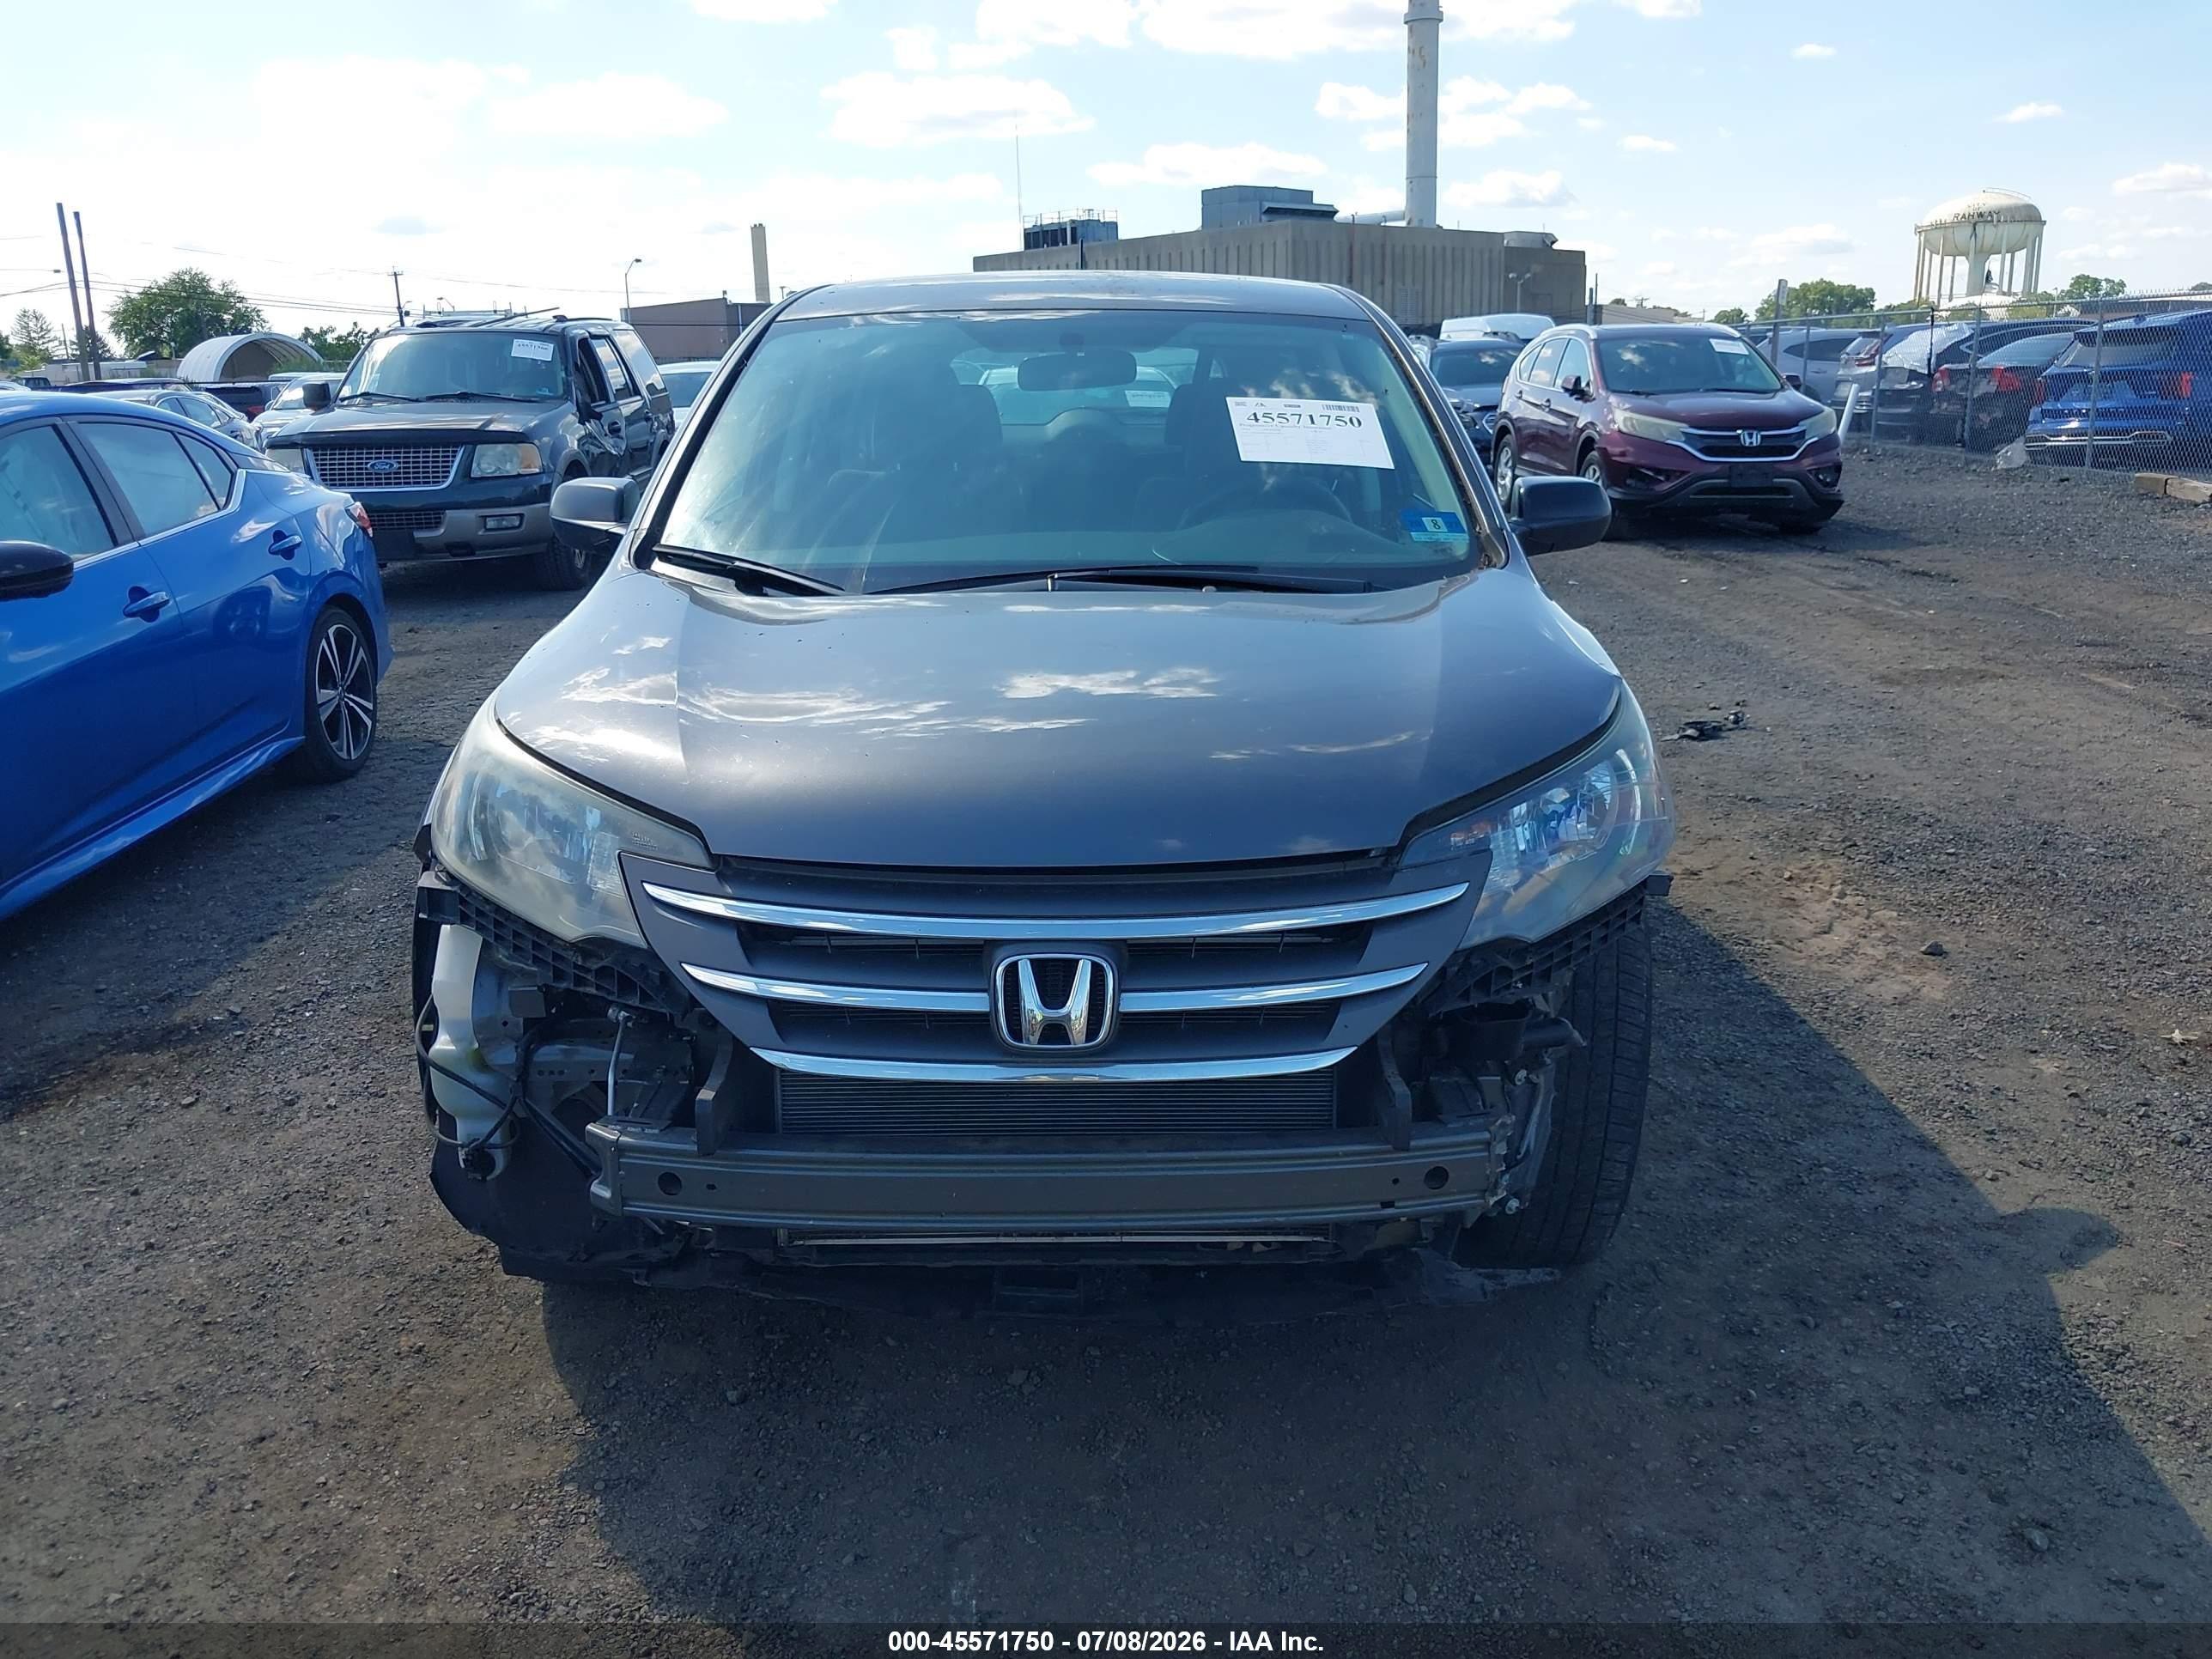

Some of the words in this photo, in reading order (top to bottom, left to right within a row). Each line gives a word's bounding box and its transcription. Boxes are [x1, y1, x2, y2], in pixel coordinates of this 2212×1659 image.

[1952, 210, 2001, 221] RAHWAY
[1246, 411, 1363, 428] 45571750
[1430, 519, 1442, 530] 8
